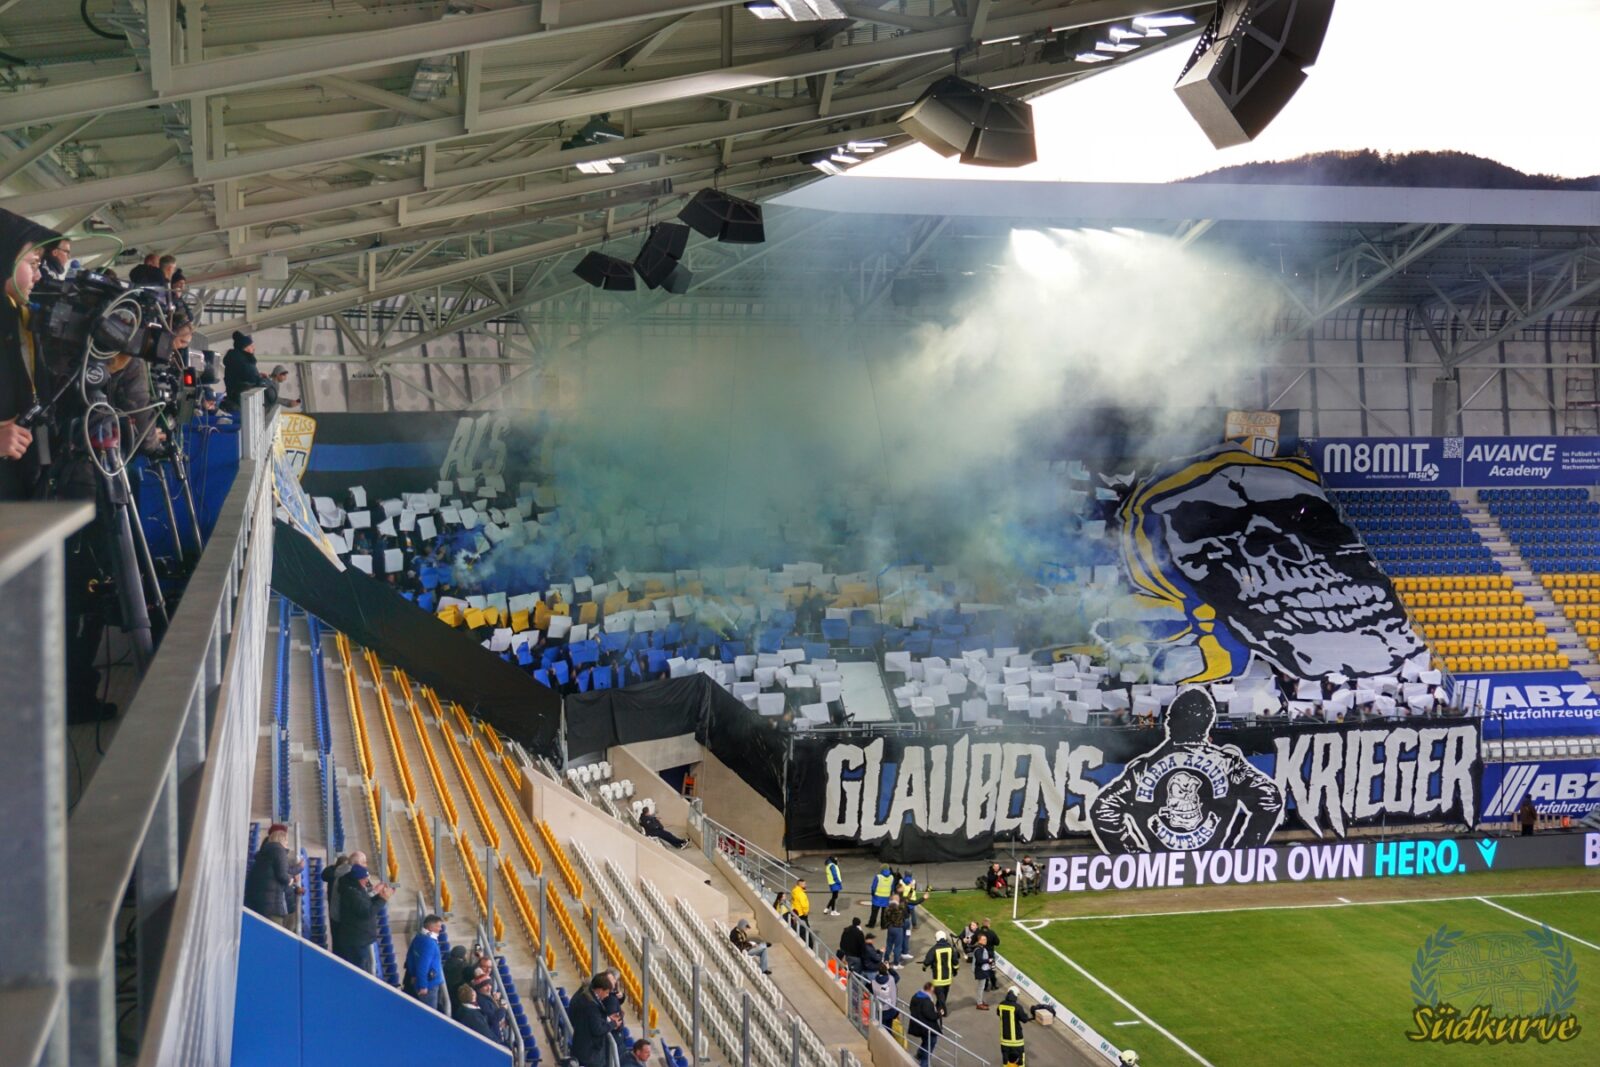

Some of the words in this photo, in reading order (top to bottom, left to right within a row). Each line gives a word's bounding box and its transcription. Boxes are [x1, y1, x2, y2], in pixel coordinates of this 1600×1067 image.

[286, 415, 314, 433] ZEISS
[1466, 444, 1557, 462] AVANCE
[1489, 464, 1552, 479] Academy
[1491, 685, 1598, 709] ABZ
[823, 735, 1104, 842] GLAUBENS
[1138, 756, 1178, 800] HORDA
[1183, 754, 1228, 797] AZZURO
[1274, 725, 1479, 838] KRIEGER
[1157, 826, 1214, 849] ULTRAS
[1047, 853, 1186, 892] BECOME
[1190, 847, 1278, 887] YOUR
[1287, 843, 1364, 880] OWN
[1375, 839, 1466, 877] HERO.
